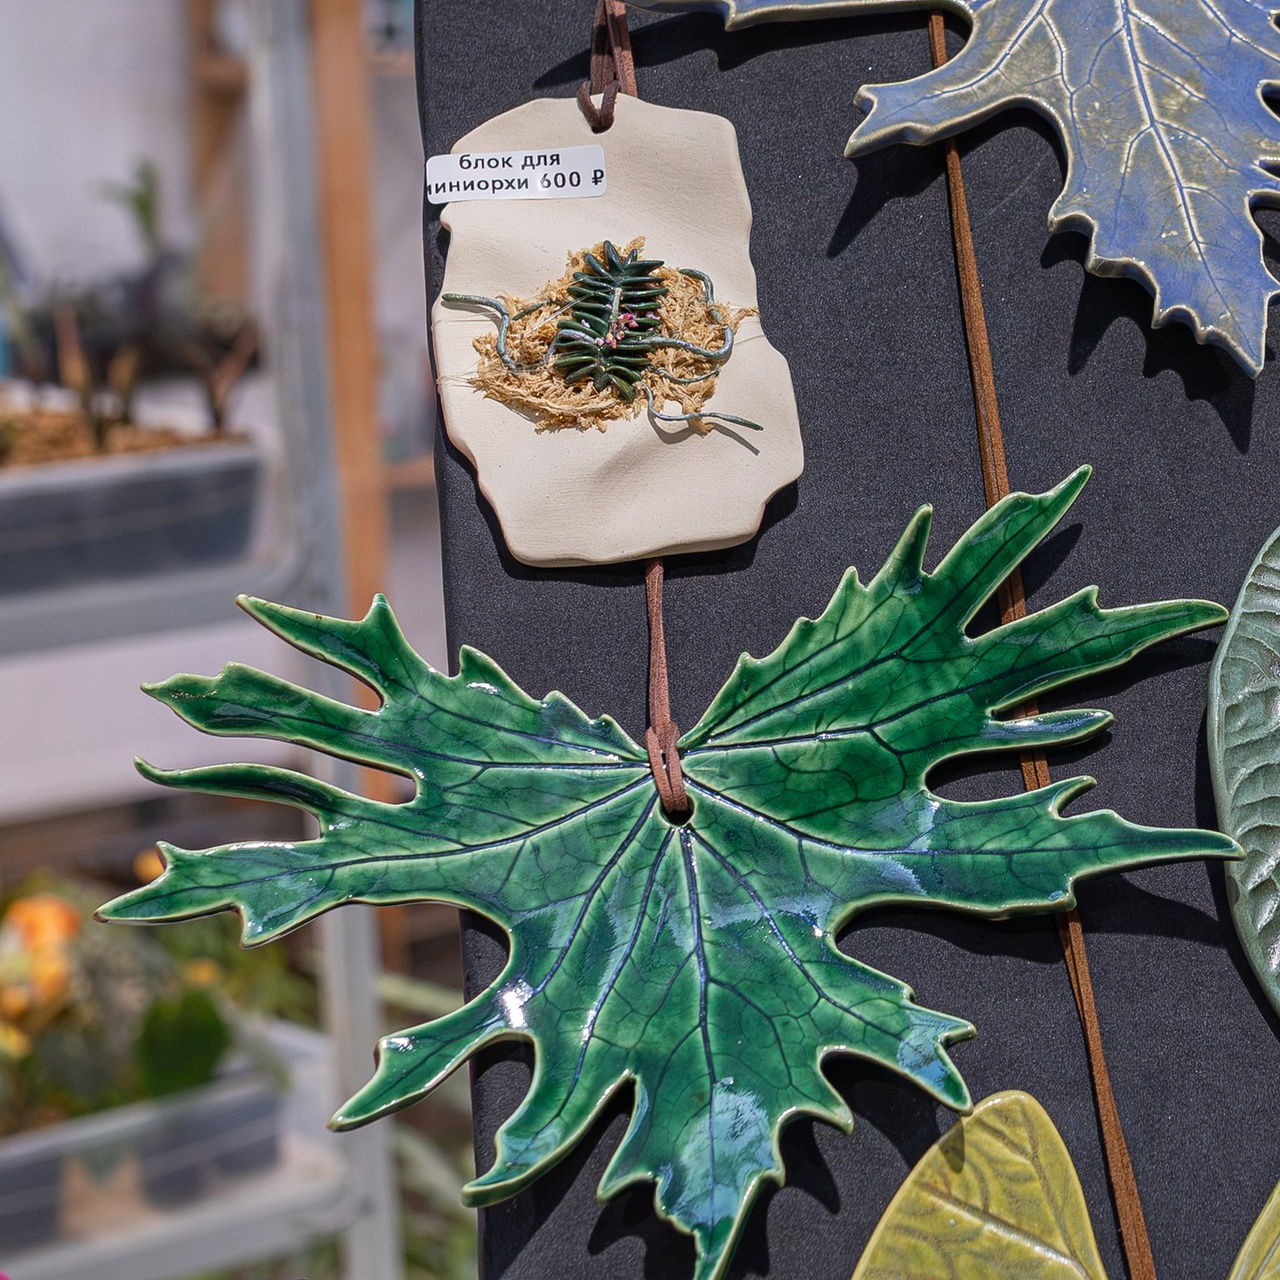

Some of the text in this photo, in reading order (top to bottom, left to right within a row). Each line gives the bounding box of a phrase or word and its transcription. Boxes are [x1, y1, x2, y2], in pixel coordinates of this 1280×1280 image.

[459, 154, 560, 170] блок для
[540, 171, 581, 188] 600
